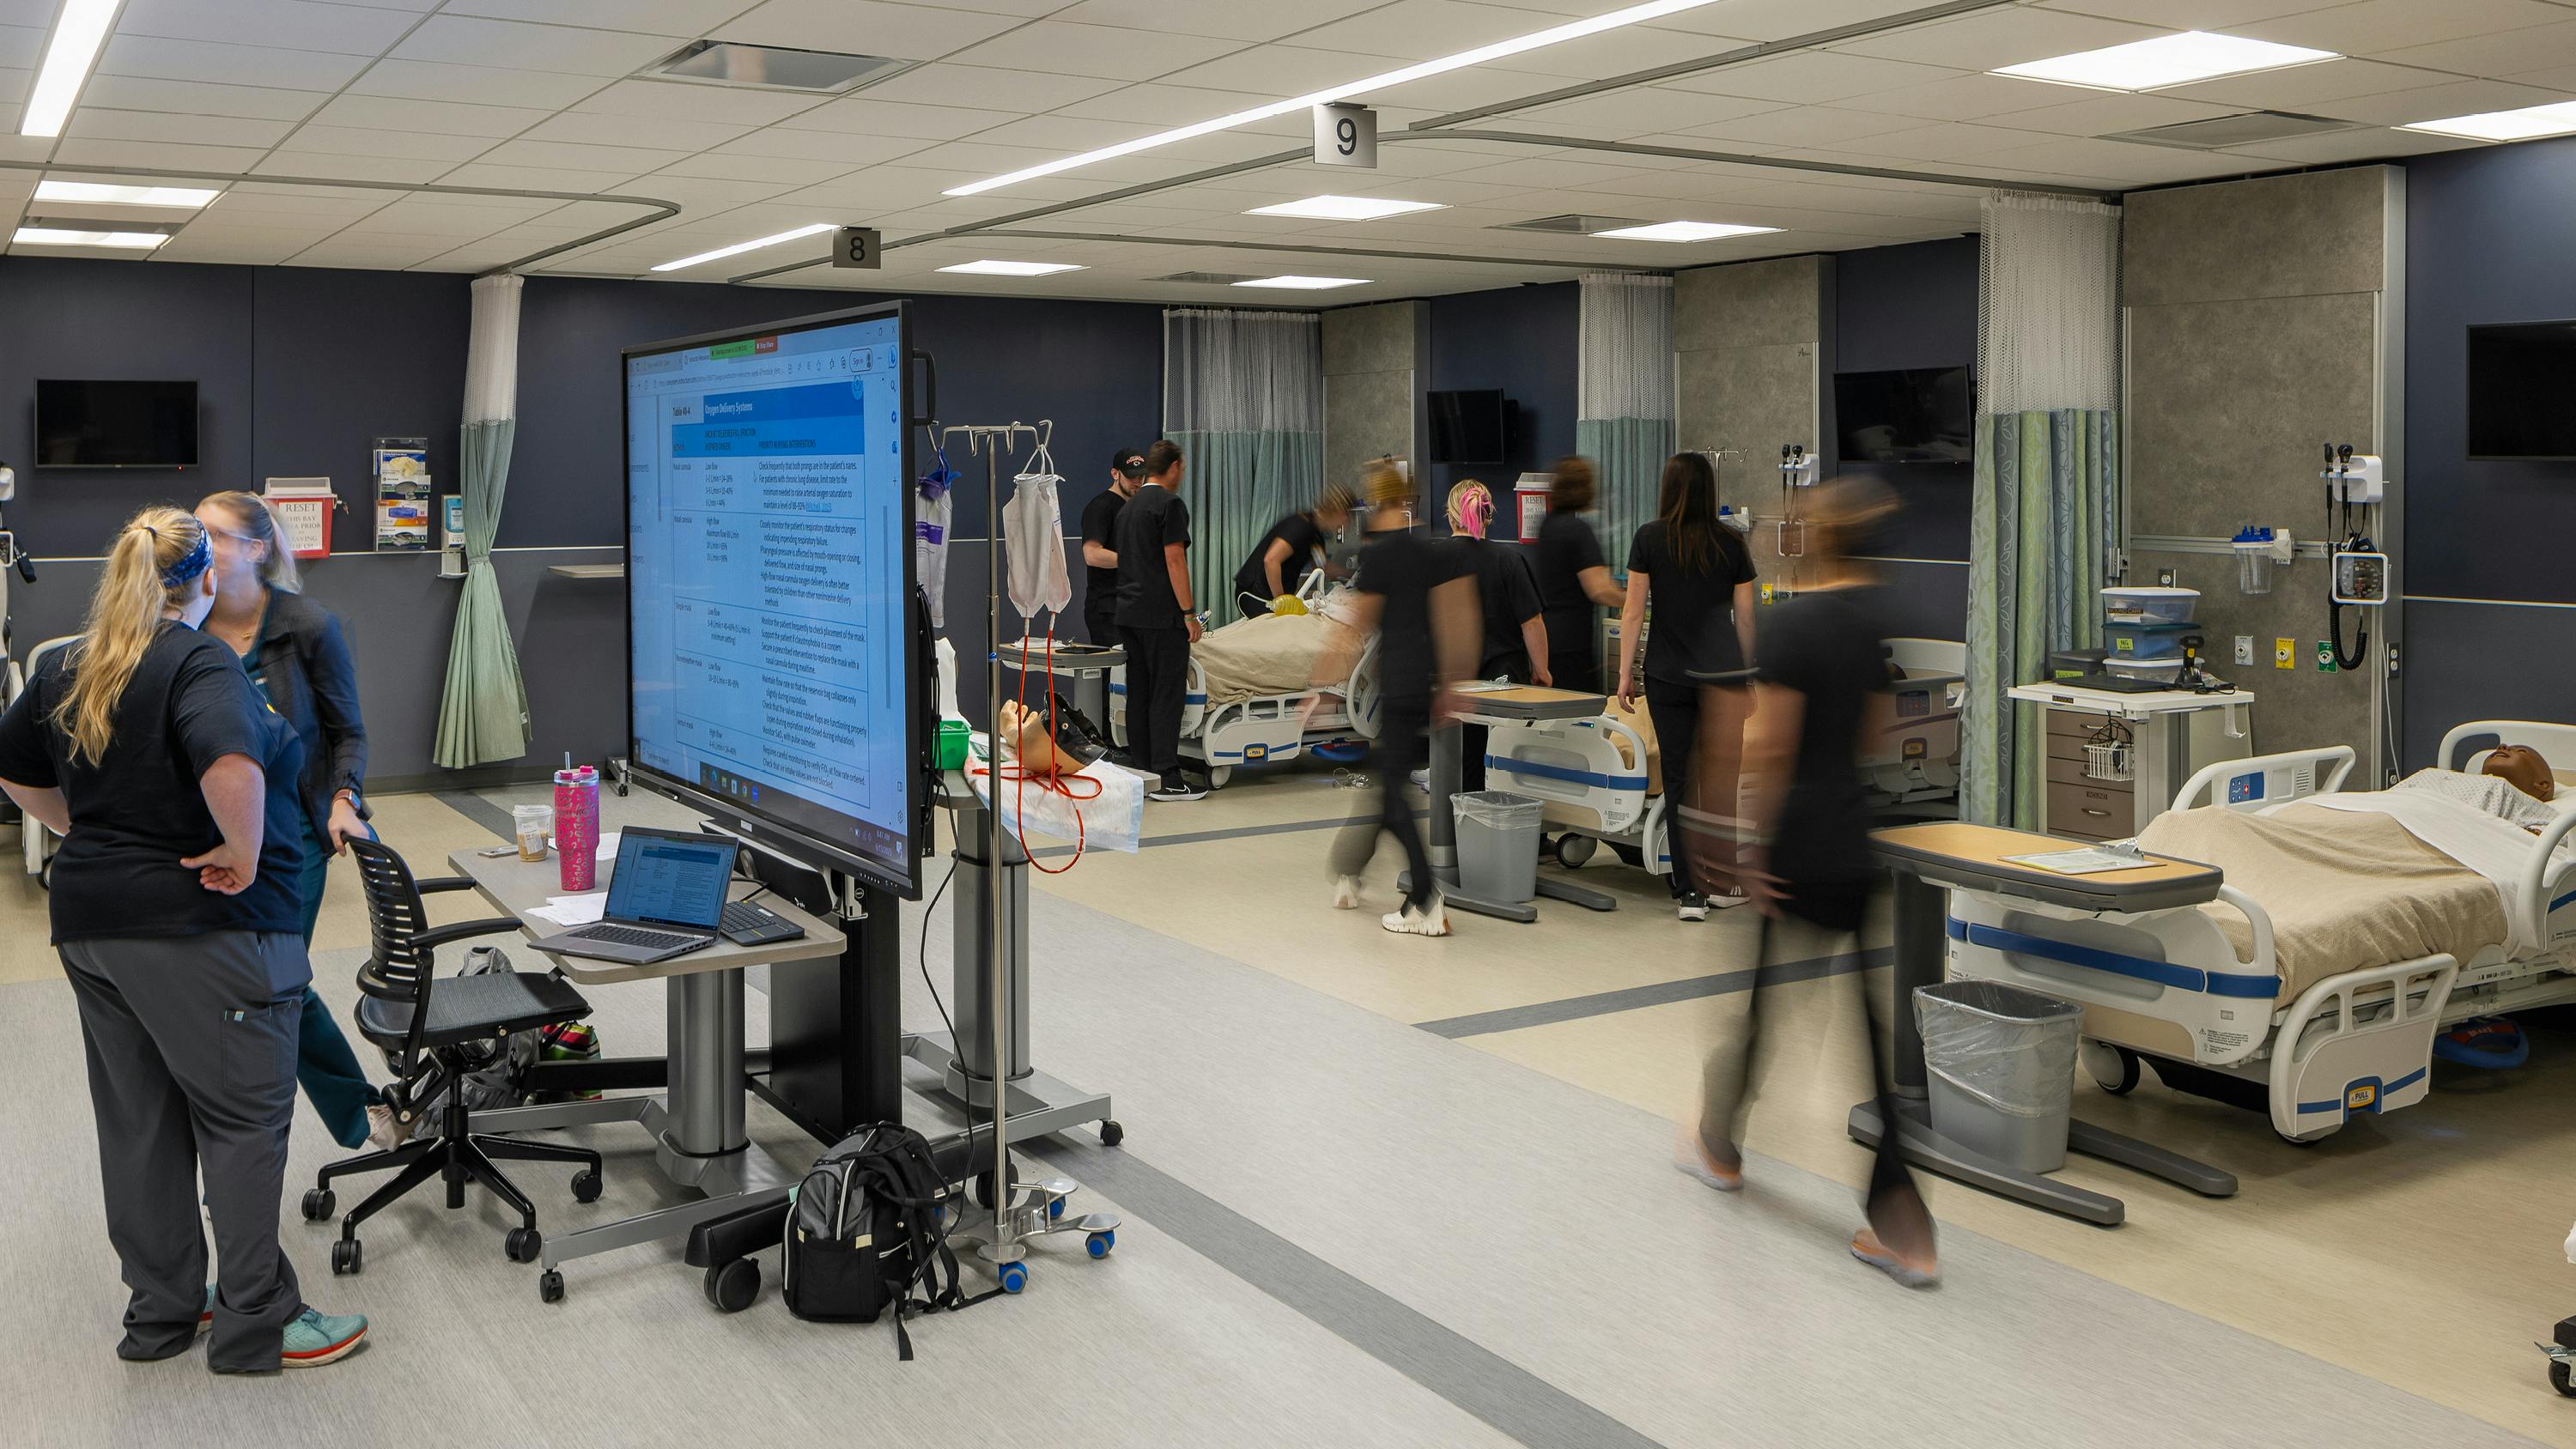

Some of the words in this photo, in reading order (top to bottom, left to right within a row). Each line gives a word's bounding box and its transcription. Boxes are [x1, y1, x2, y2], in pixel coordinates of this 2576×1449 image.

[1336, 117, 1357, 155] 9
[849, 235, 866, 262] 8
[673, 406, 682, 415] Table
[705, 405, 720, 416] Oxygen
[720, 403, 735, 415] Delivery
[735, 402, 752, 414] Systems
[286, 503, 317, 512] RESET
[760, 520, 771, 530] Closely
[771, 521, 784, 530] monitor
[791, 523, 805, 532] patient's
[805, 524, 823, 534] respiratory
[841, 525, 857, 536] changes
[762, 616, 773, 626] Monitor
[780, 620, 791, 629] patient
[792, 621, 808, 634] frequently
[813, 626, 823, 634] check
[823, 627, 842, 637] placement
[2467, 1027, 2494, 1037] BRAKE
[2355, 1091, 2368, 1100] PULL
